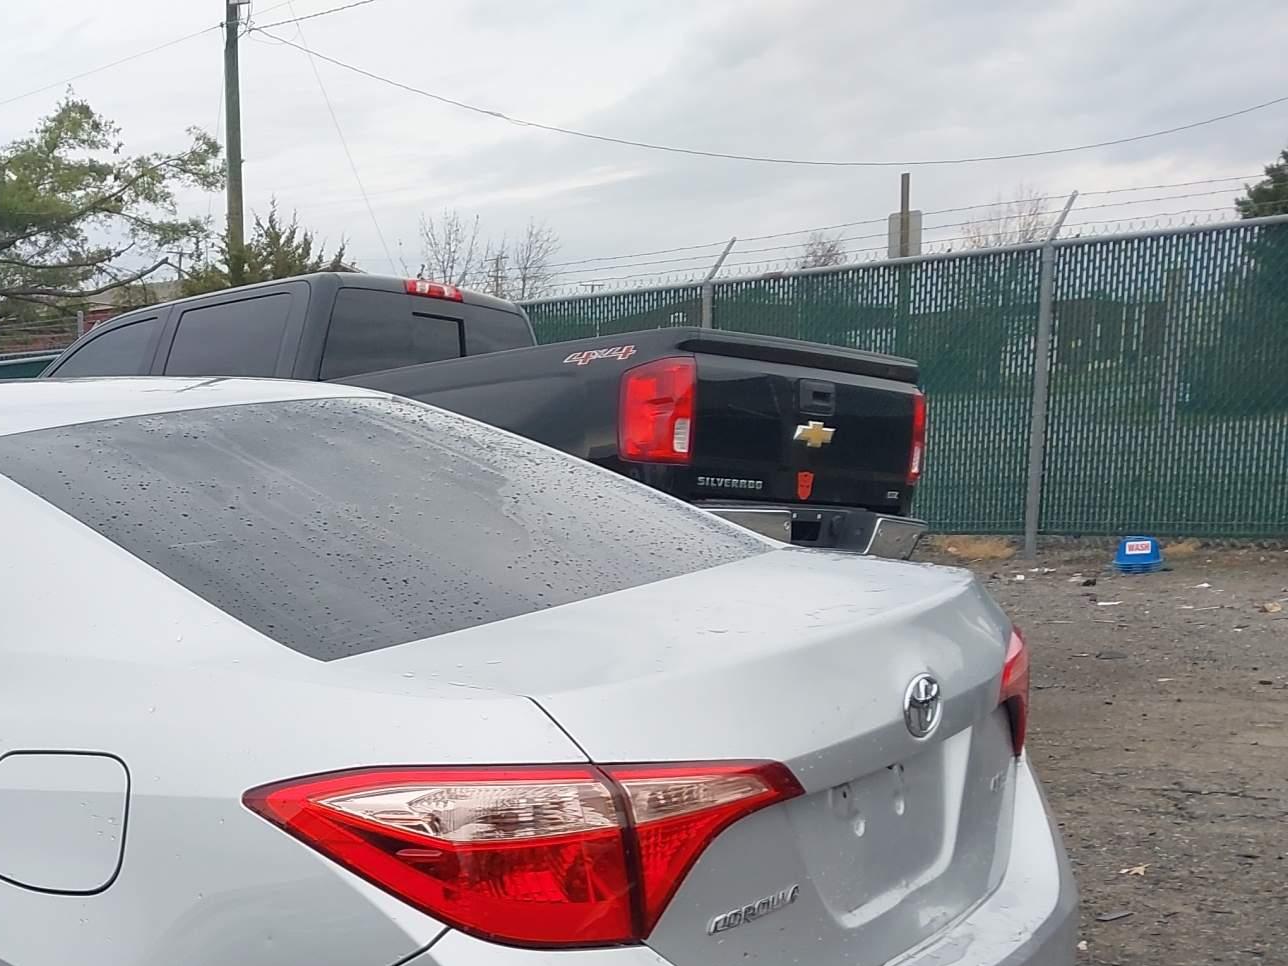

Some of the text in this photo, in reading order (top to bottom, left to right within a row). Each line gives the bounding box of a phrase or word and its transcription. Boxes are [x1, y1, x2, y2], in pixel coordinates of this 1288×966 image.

[697, 476, 763, 490] SILVERADO
[1127, 543, 1150, 553] WASH
[707, 884, 799, 936] COROLLA
